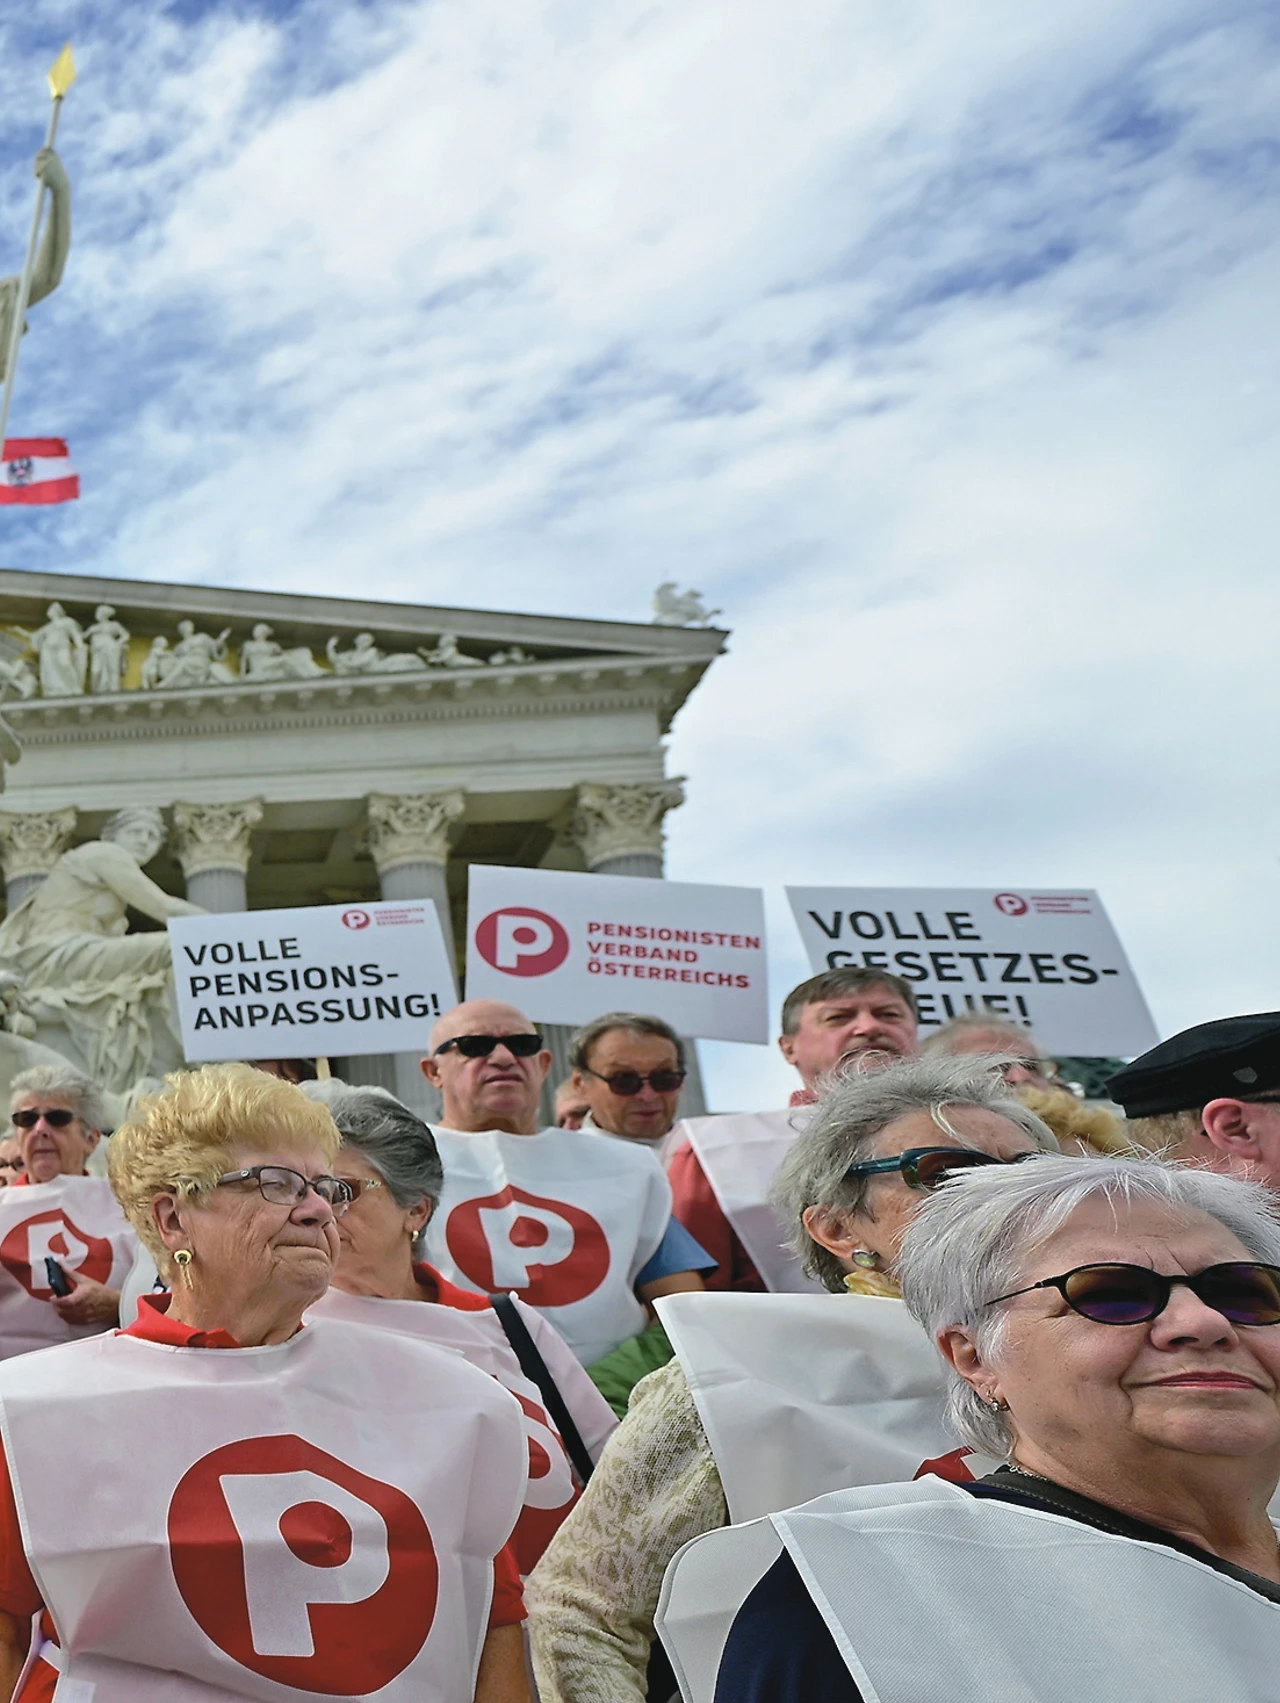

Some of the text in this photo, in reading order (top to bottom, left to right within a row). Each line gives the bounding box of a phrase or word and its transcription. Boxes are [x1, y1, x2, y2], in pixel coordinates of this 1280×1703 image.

[587, 921, 761, 949] PENSIONISTEN
[808, 911, 982, 940] VOLLE
[184, 938, 301, 966] VOLLE
[587, 941, 698, 963] VERBAND
[190, 964, 399, 998] PENSIONS-
[587, 957, 750, 989] ÖSTERREICHS
[194, 993, 441, 1030] ANPASSUNG!
[917, 994, 1033, 1027] EUE!
